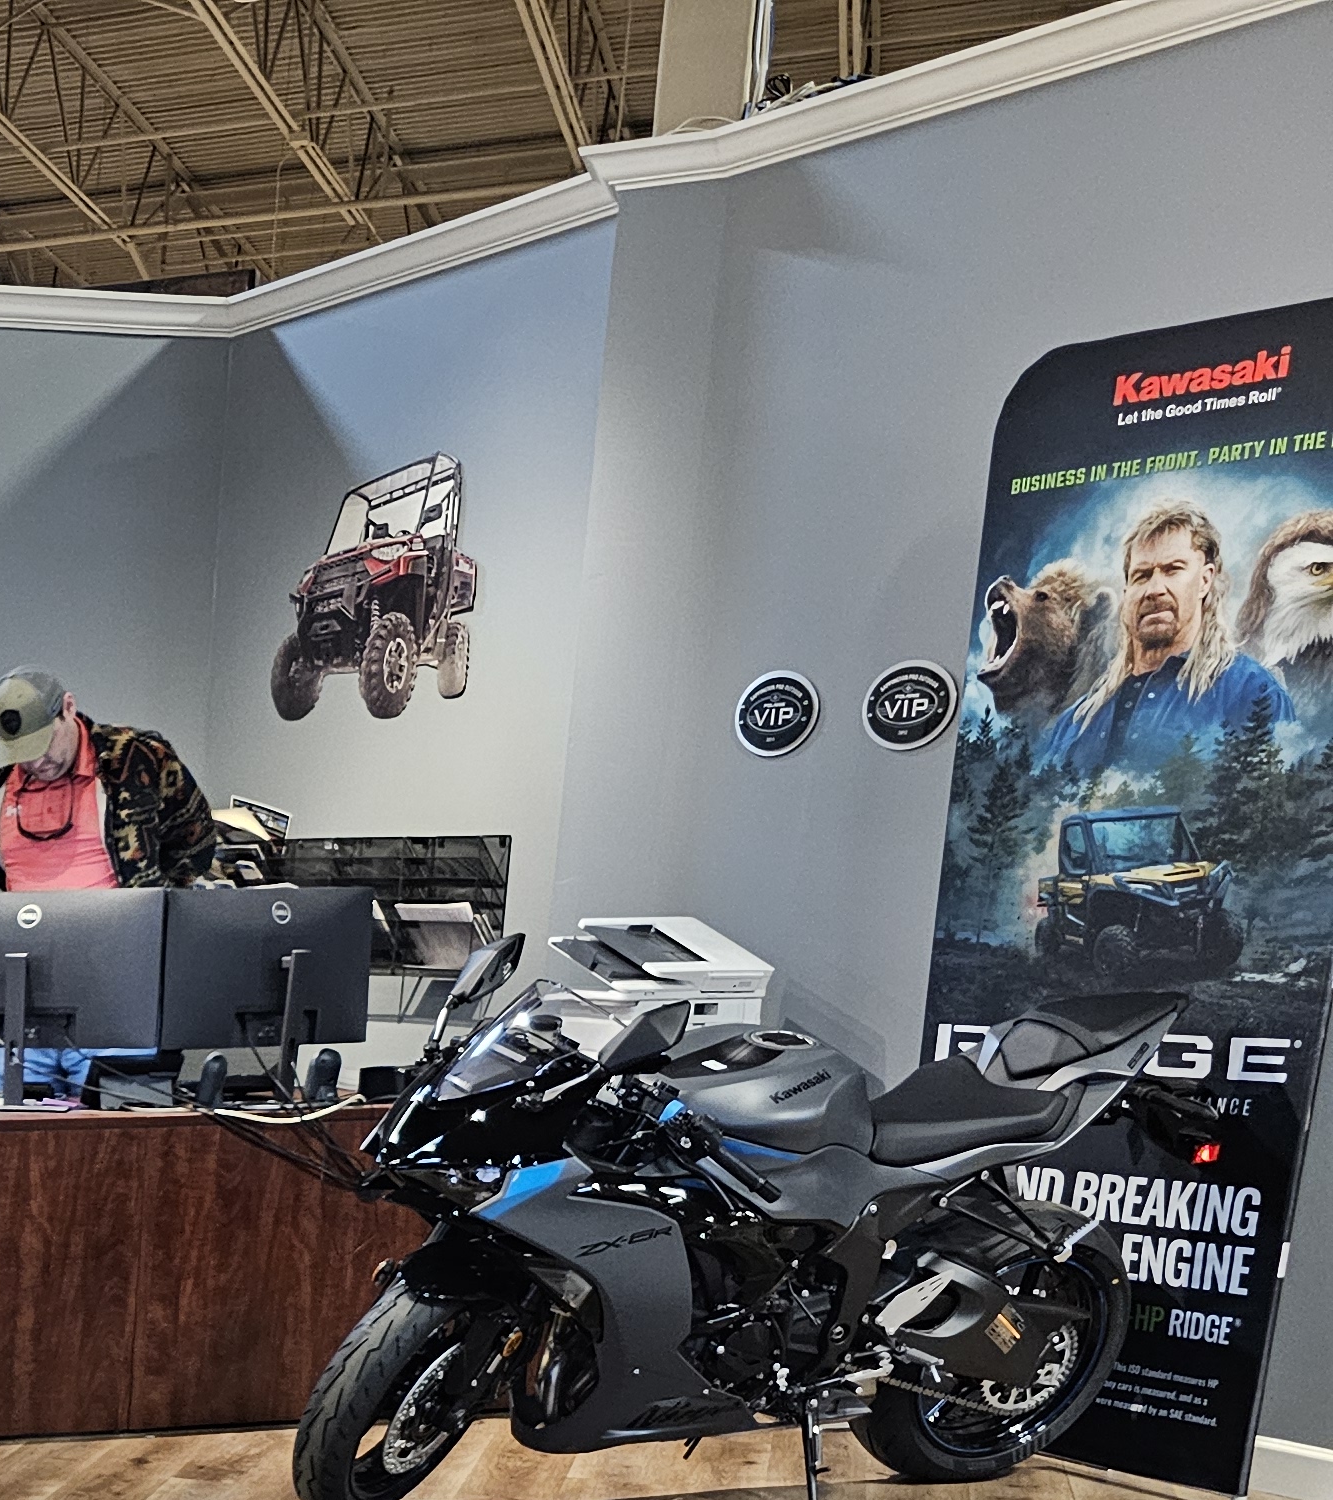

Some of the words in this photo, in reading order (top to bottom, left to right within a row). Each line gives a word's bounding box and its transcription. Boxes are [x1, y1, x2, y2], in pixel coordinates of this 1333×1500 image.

[1113, 346, 1292, 406] Kawasaki
[1117, 410, 1138, 426] Let
[1140, 408, 1163, 423] the
[1165, 400, 1202, 418] Good
[1203, 395, 1246, 412] Times
[1010, 467, 1086, 495] BUSINESS
[1089, 464, 1107, 482] IN
[1111, 459, 1141, 479] THE
[1145, 450, 1202, 475] FRONT.
[1207, 440, 1265, 466] PARTY
[1268, 436, 1289, 456] IN
[1293, 430, 1328, 453] THE
[754, 707, 794, 727] VIP
[884, 698, 929, 719] VIP
[769, 1068, 832, 1104] Kawasaki
[1071, 1170, 1262, 1237] BREAKING
[575, 1225, 673, 1258] ZX-6R
[1121, 1233, 1256, 1296] ENGINE
[1141, 1367, 1173, 1381] standard
[1207, 1378, 1219, 1389] HP
